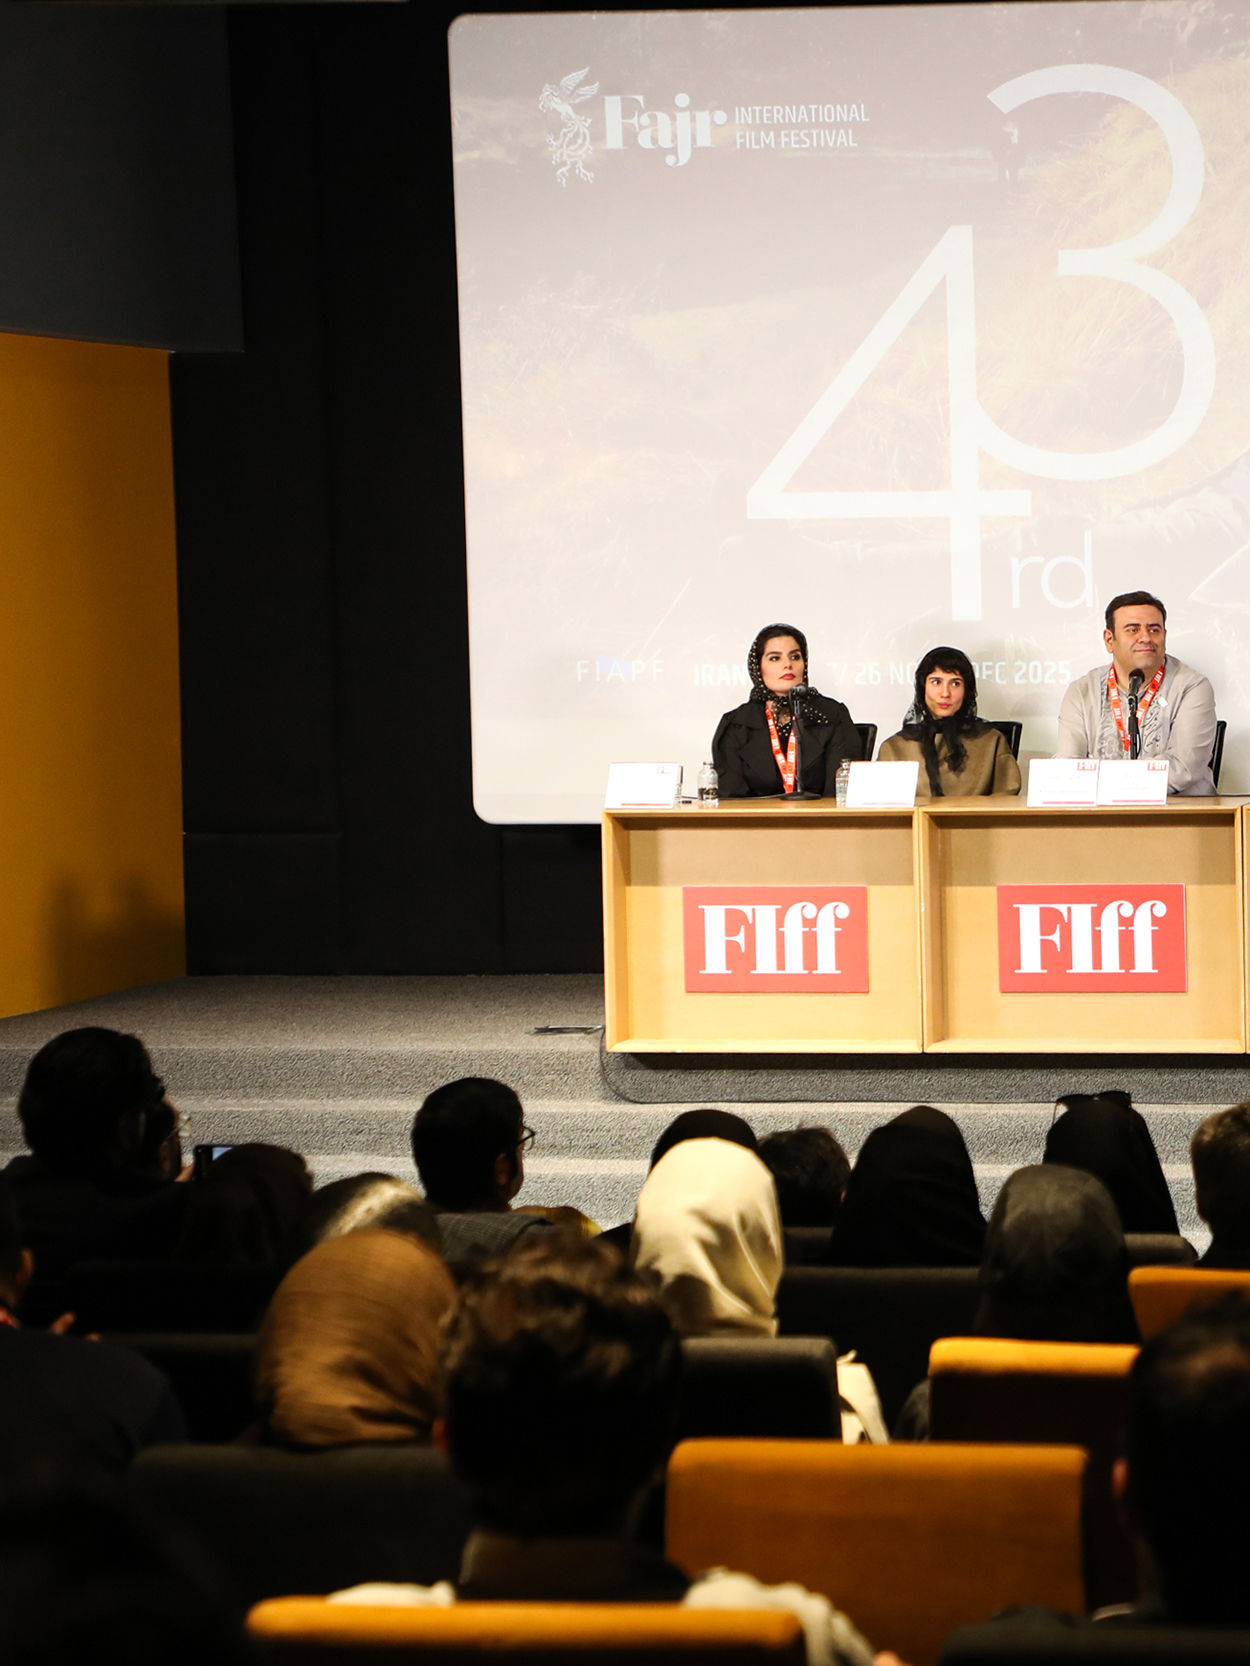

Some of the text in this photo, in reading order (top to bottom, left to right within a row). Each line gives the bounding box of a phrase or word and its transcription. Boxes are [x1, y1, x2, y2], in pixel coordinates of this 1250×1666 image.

[735, 103, 870, 125] INTERNATIONAL
[604, 93, 727, 167] Fajr
[736, 129, 858, 149] FILM FESTIVAL
[576, 659, 665, 682] FIAPF
[855, 662, 881, 685] 26
[889, 661, 915, 685] NO
[1014, 660, 1072, 684] 2025
[698, 901, 850, 974] FIff
[1013, 900, 1167, 973] FIff
